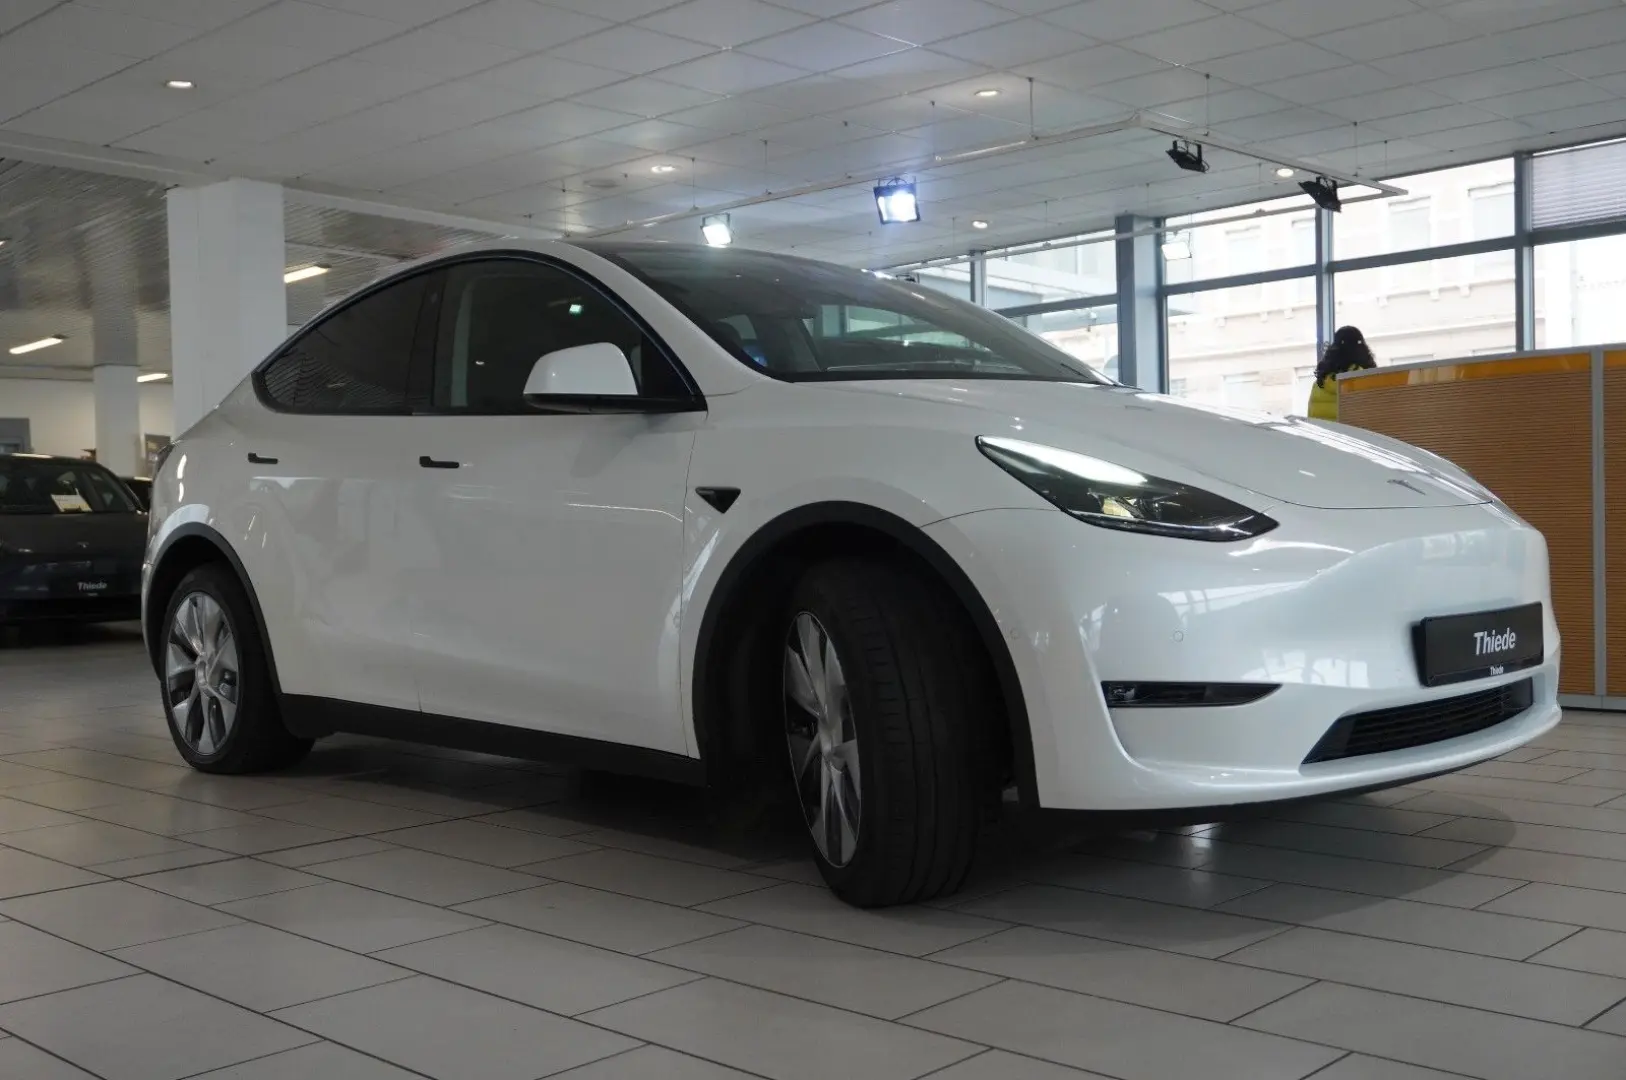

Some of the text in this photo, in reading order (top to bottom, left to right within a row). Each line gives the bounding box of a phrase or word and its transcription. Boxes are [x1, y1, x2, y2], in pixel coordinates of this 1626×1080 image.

[77, 580, 107, 590] Thiede
[1473, 627, 1516, 656] Thiede
[1490, 664, 1504, 676] Thiede
